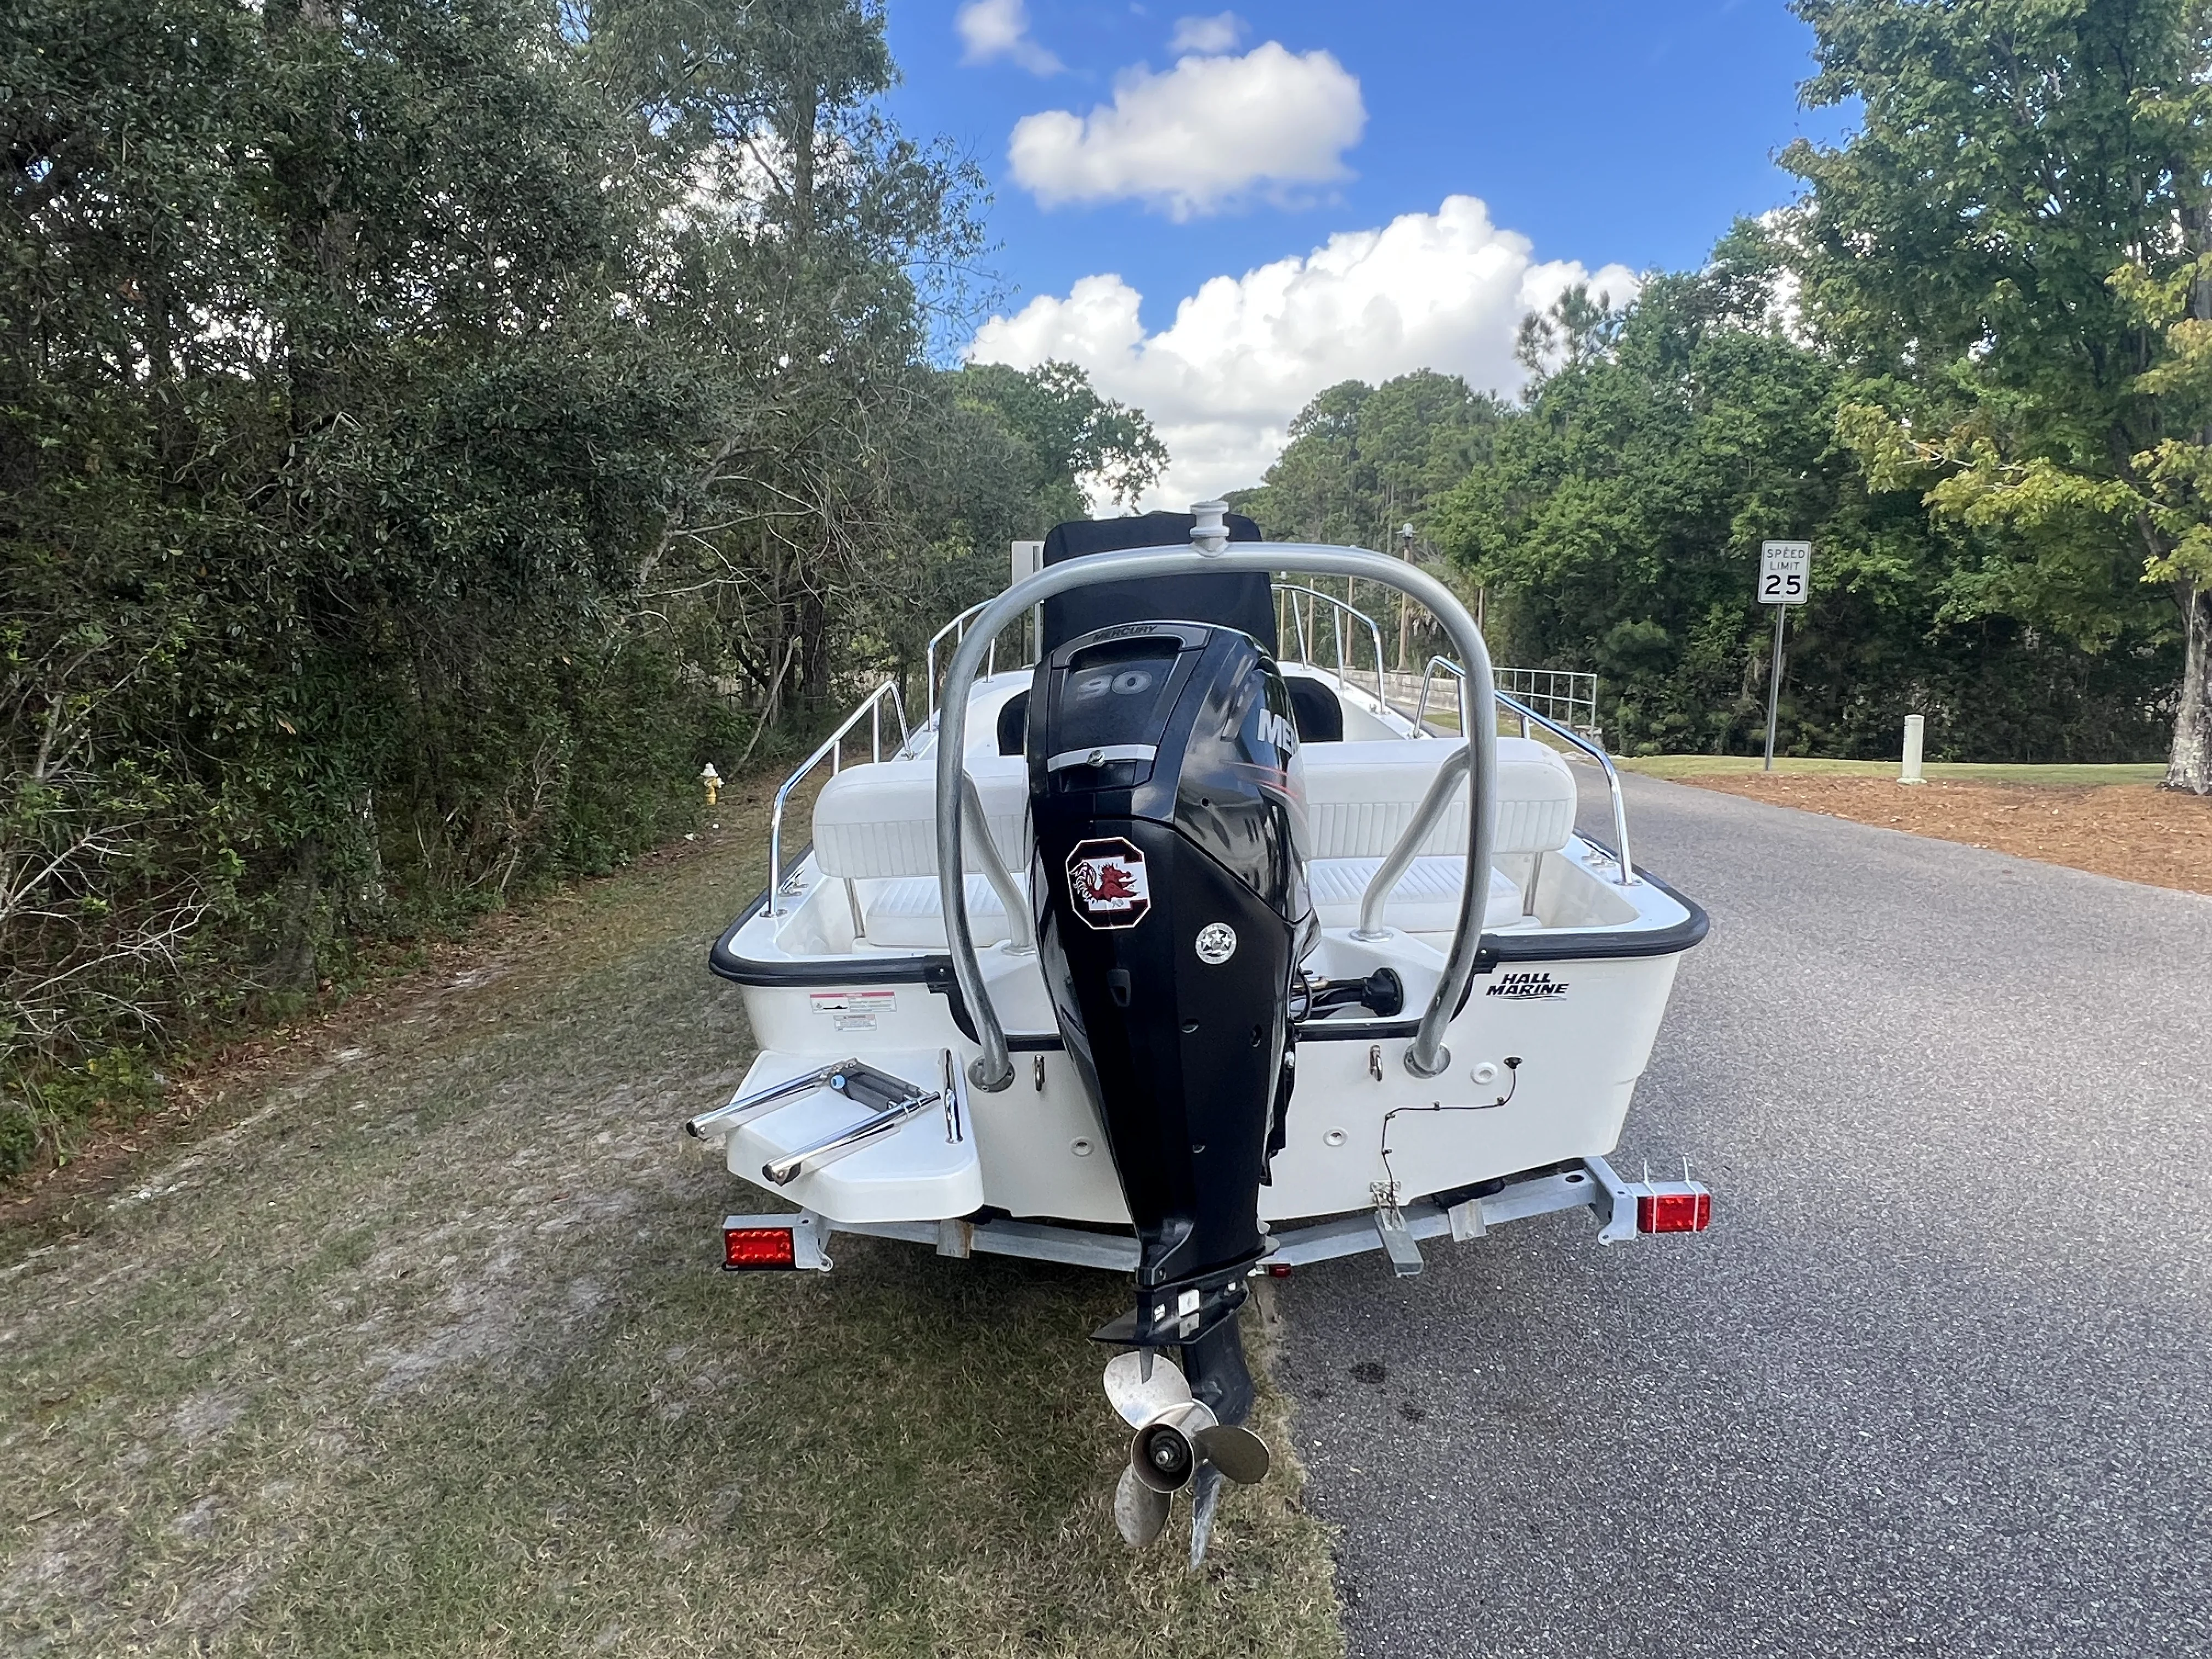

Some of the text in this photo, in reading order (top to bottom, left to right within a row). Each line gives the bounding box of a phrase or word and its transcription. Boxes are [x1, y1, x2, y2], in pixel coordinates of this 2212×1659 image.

[1767, 549, 1805, 558] SPEED
[1770, 561, 1799, 570] LIMIT
[1765, 574, 1801, 595] 25
[1092, 625, 1158, 642] MERCURY
[1076, 670, 1152, 701] 90
[1502, 973, 1551, 984] HALL
[1486, 983, 1570, 996] MARINE
